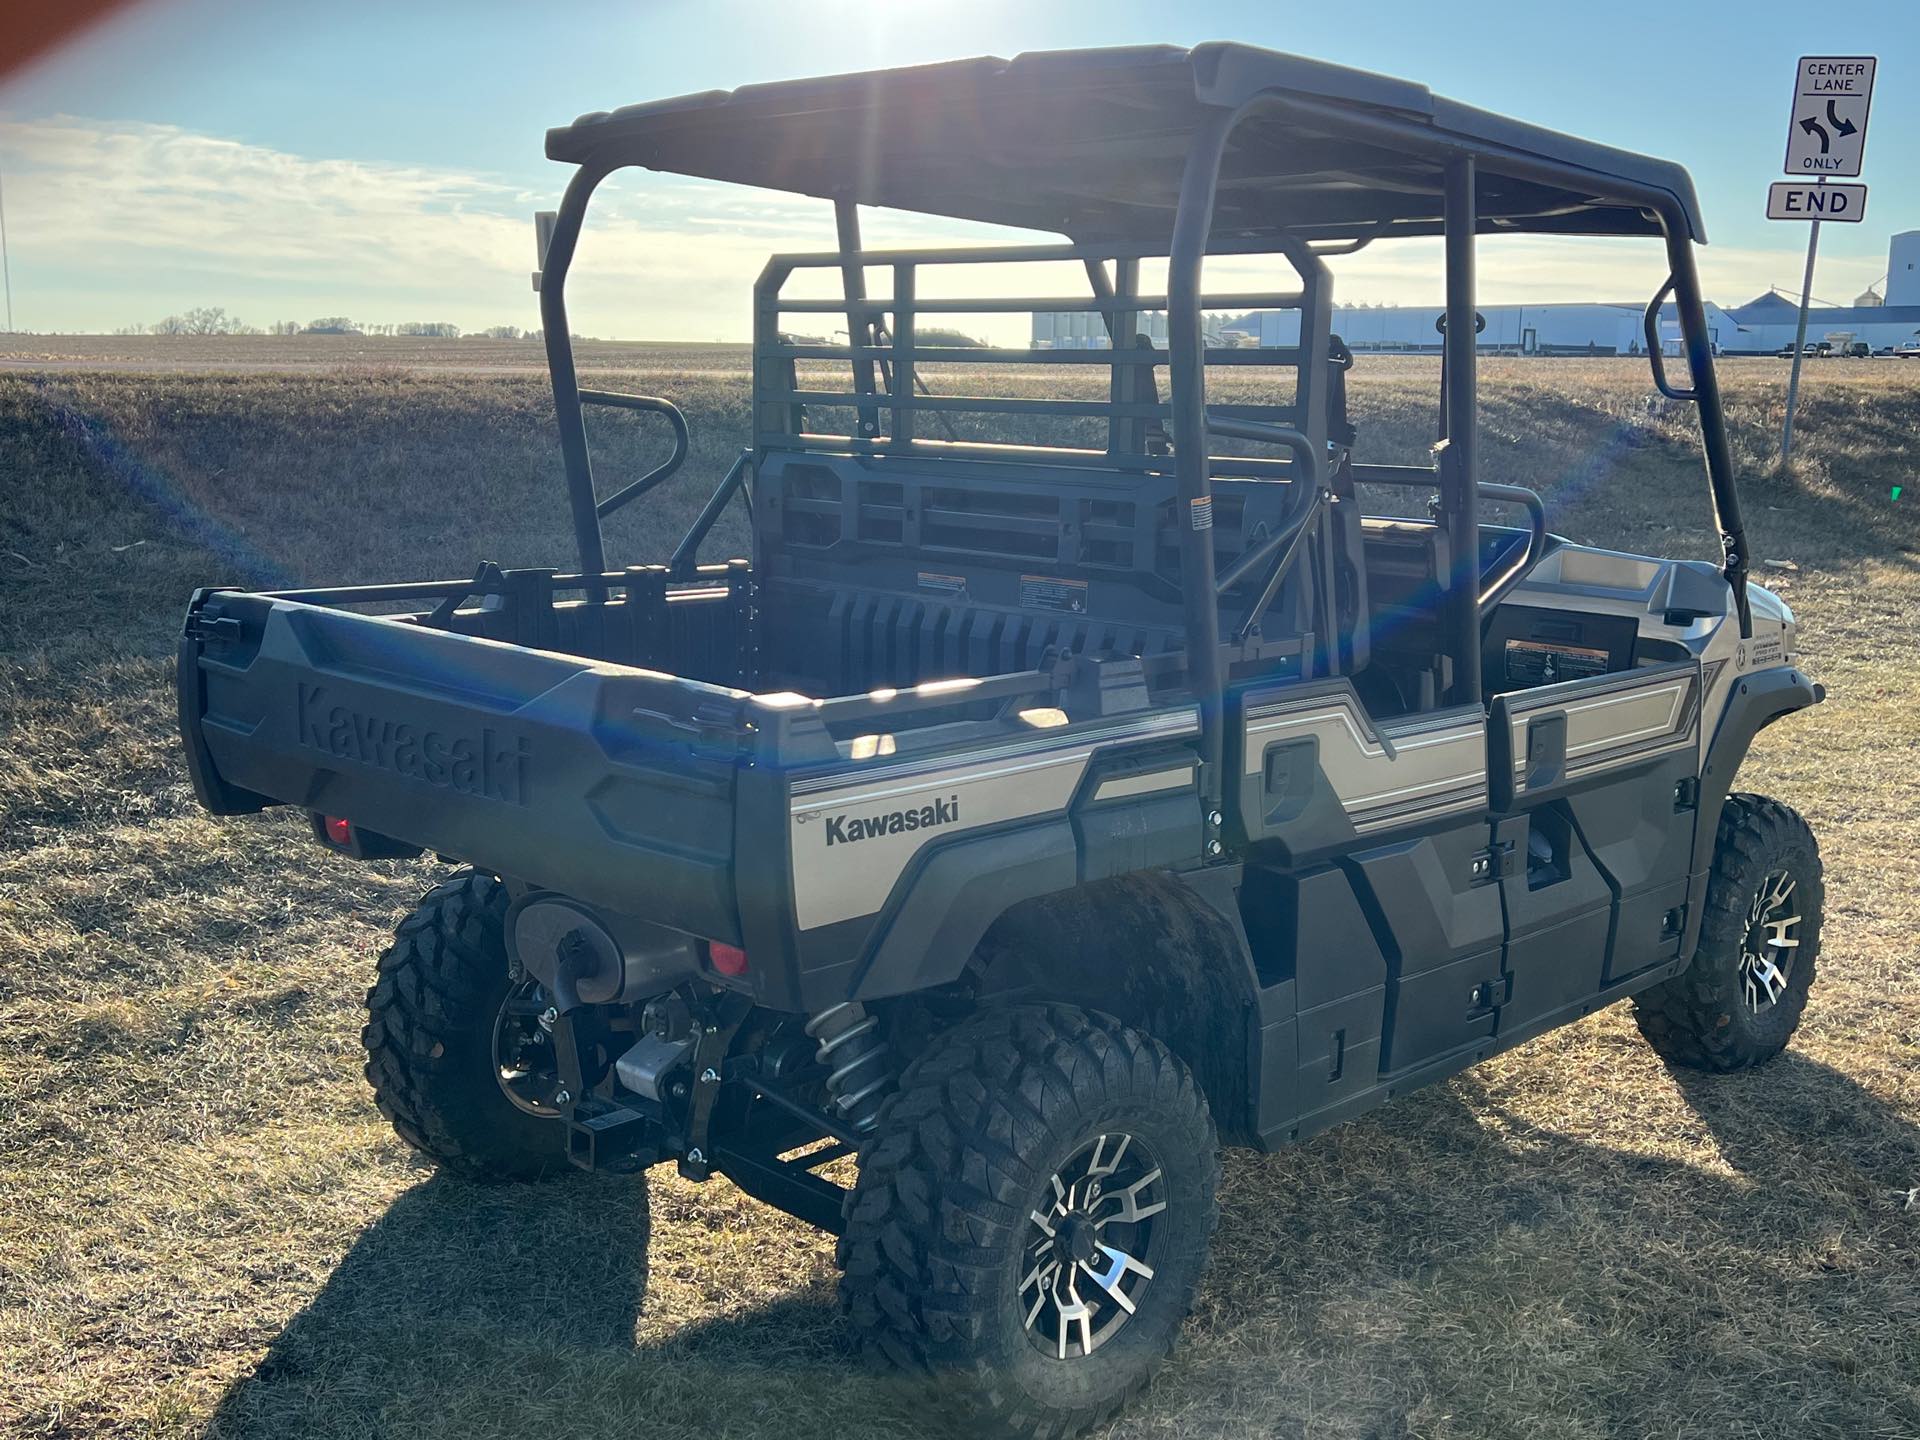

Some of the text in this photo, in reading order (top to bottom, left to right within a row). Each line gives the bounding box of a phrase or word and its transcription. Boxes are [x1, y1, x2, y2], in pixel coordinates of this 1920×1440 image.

[1808, 64, 1865, 76] CENTER
[1814, 79, 1854, 91] LANE
[1803, 157, 1843, 170] ONLY
[1785, 191, 1848, 213] END
[297, 682, 533, 809] Kawasaki
[826, 794, 959, 846] Kawasaki
